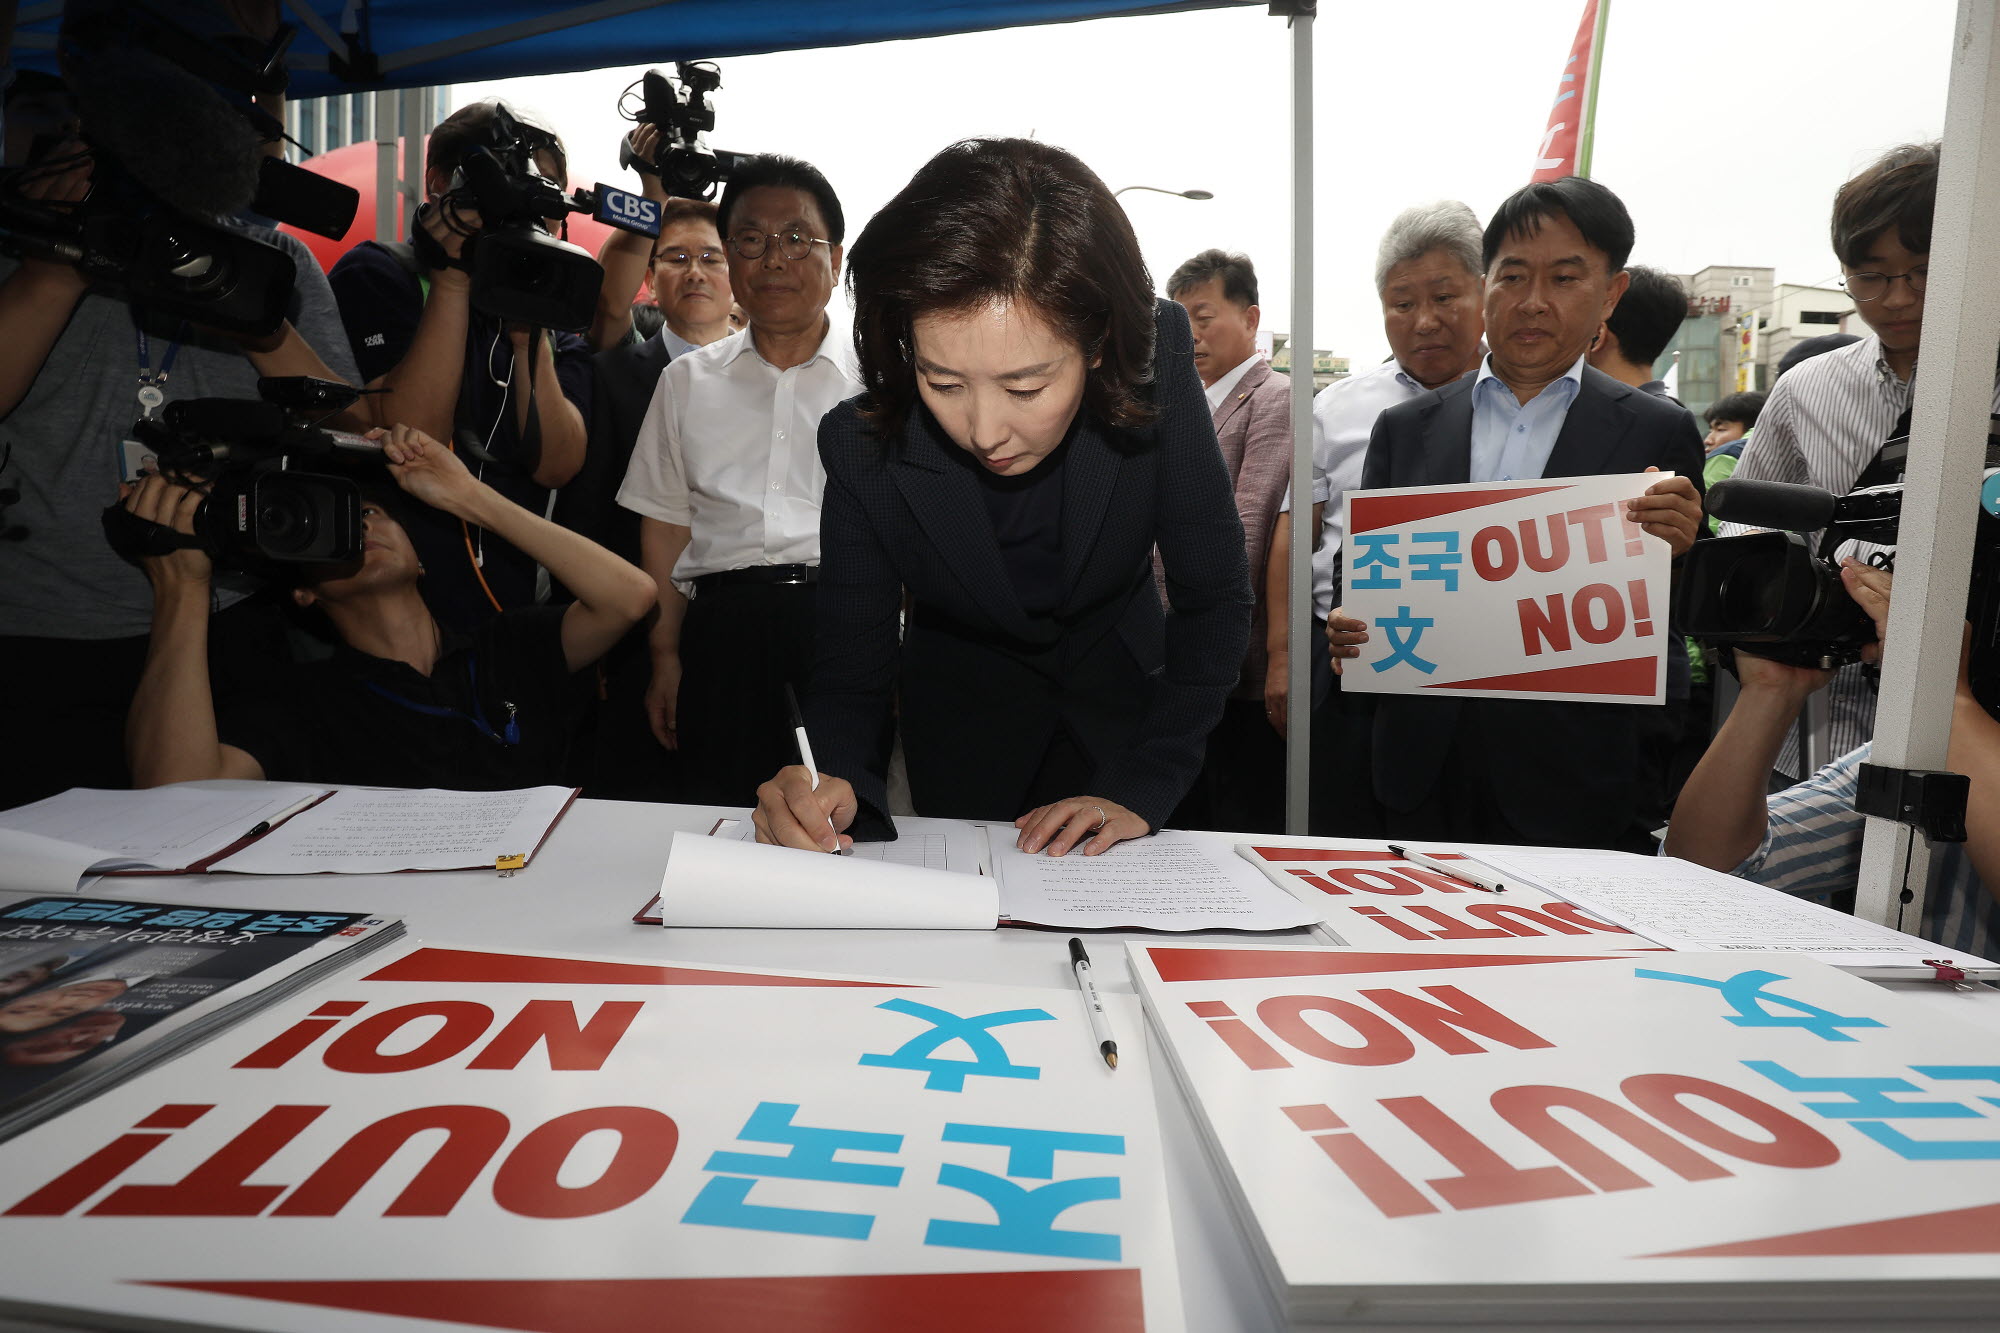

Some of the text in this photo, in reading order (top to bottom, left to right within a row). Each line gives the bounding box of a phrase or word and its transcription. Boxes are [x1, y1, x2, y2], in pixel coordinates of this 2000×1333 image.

[606, 191, 656, 223] CBS
[612, 213, 650, 230] Media Group
[1352, 500, 1645, 592] 조국 OUT!
[1371, 578, 1654, 675] 文 NO!
[141, 909, 253, 930] 임명
[239, 914, 349, 933] 조국
[232, 998, 1057, 1093] 文 NO!
[1184, 985, 1555, 1070] NO!
[1636, 968, 1889, 1042] 文
[1, 1101, 1126, 1263] 조국 OUT!
[1280, 1073, 1840, 1217] OUT!
